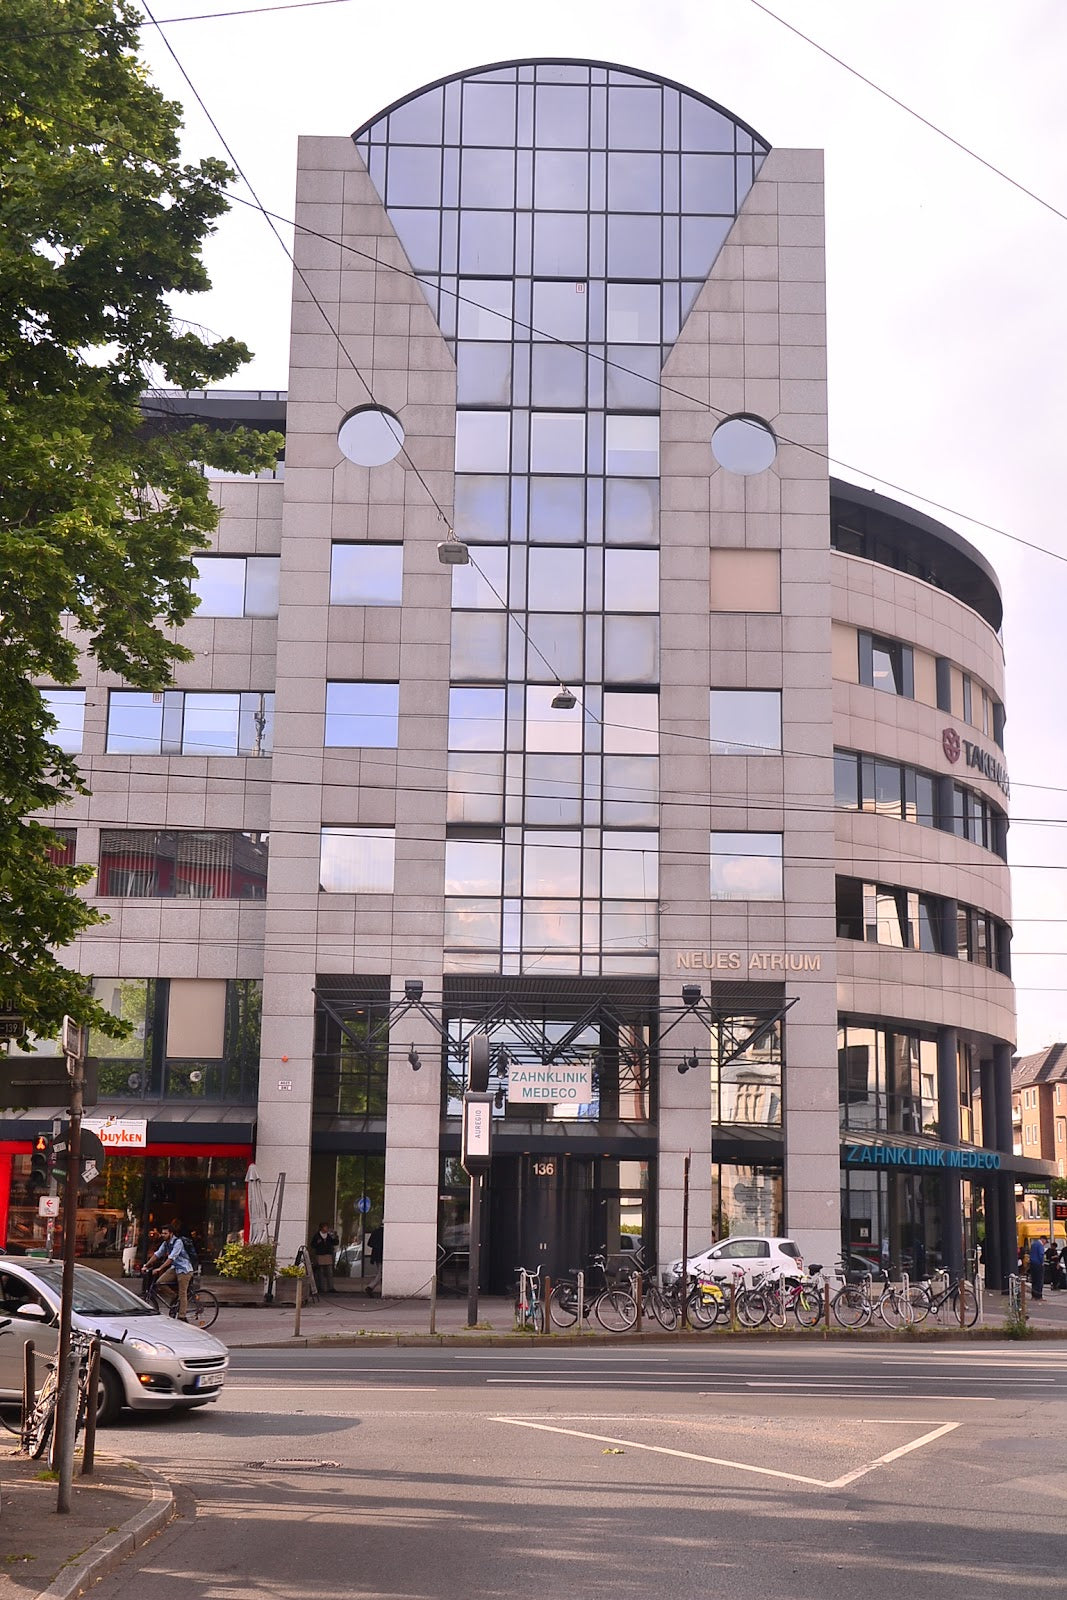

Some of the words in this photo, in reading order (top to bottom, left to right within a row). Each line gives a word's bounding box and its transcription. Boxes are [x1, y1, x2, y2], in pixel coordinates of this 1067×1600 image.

[676, 952, 741, 969] NEUES
[748, 953, 821, 971] ATRIUM
[511, 1072, 588, 1083] ZAHNKLINIK
[522, 1087, 577, 1098] MEDECO
[474, 1109, 482, 1139] AUREGIO
[847, 1144, 946, 1167] ZAHNKLINIK
[950, 1151, 1001, 1170] MEDECO
[533, 1163, 554, 1175] 136
